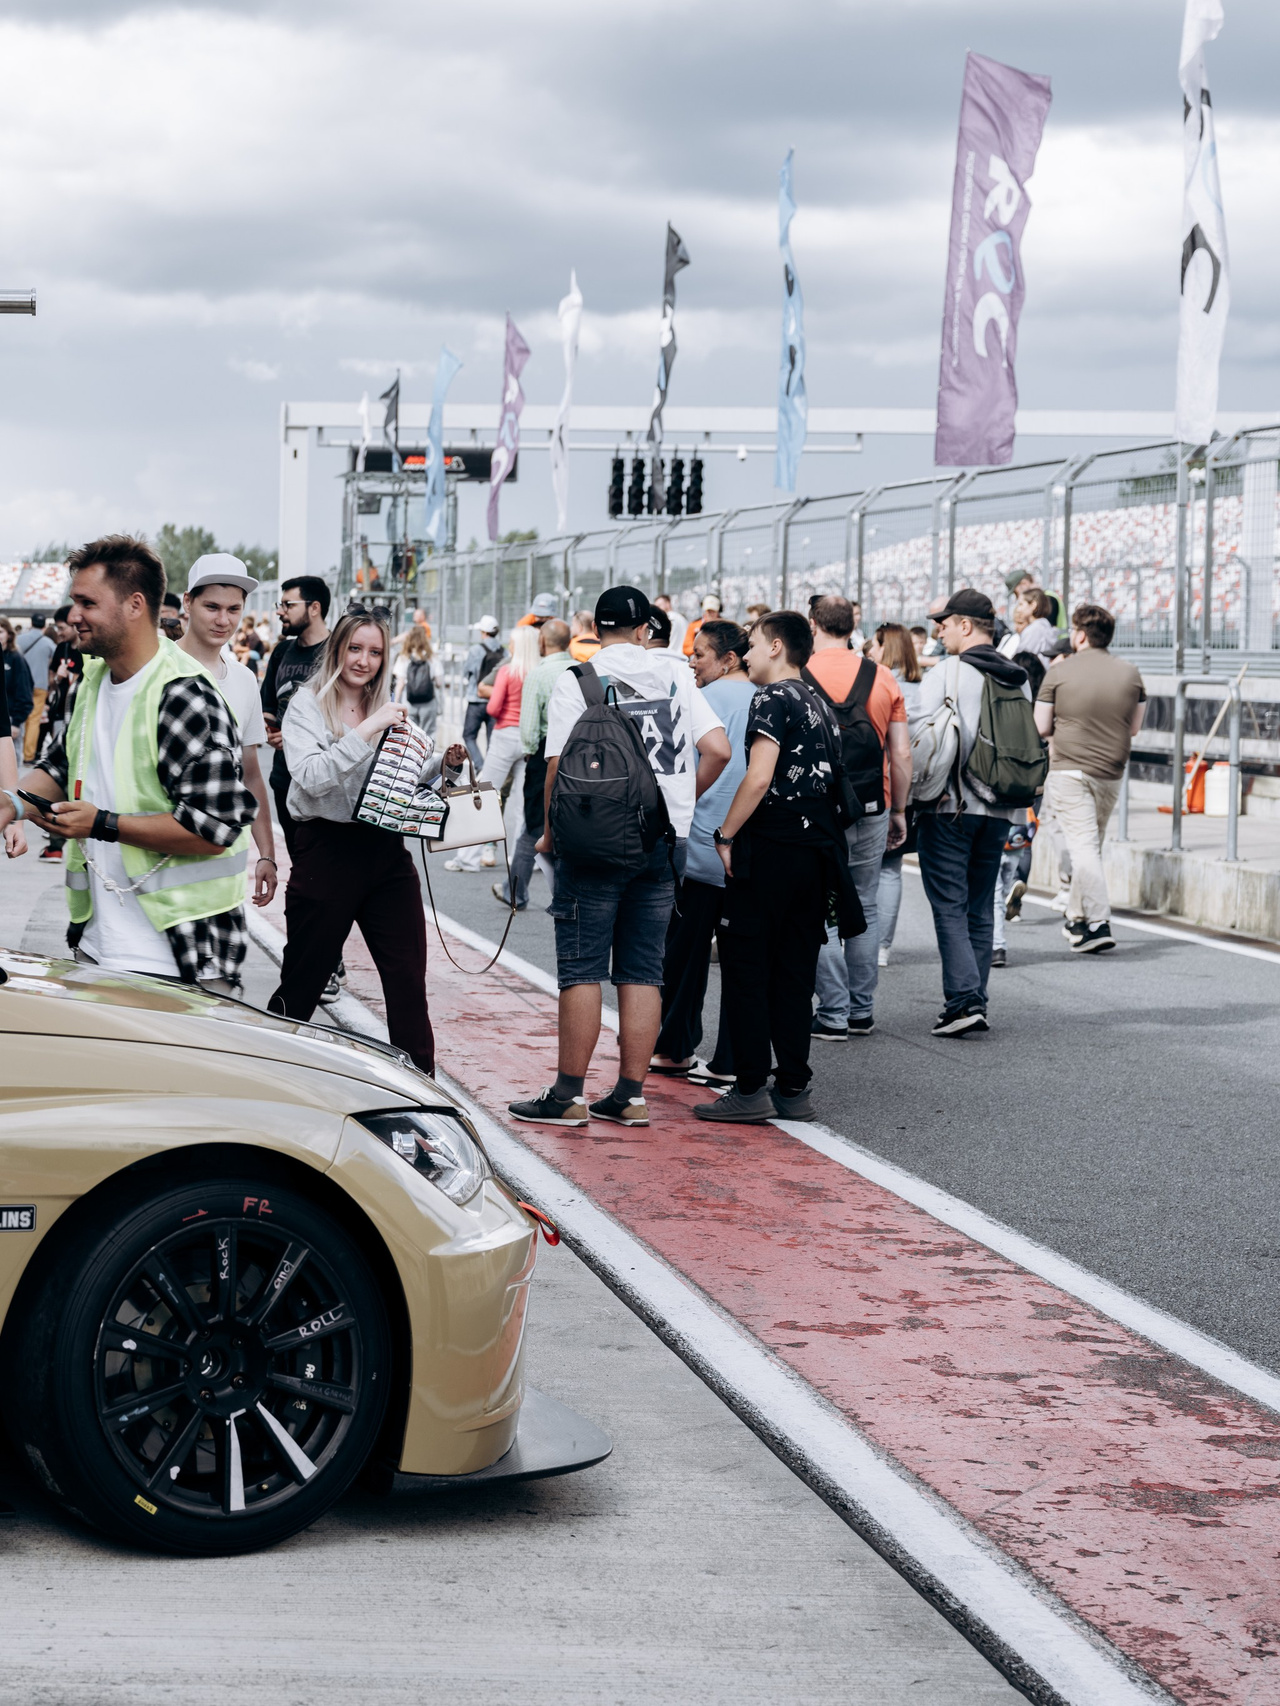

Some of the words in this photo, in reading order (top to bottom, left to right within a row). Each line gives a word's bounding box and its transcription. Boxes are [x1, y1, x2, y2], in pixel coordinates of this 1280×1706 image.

[243, 1196, 273, 1216] FR
[273, 1260, 295, 1290] and
[298, 1310, 343, 1338] ROLL
